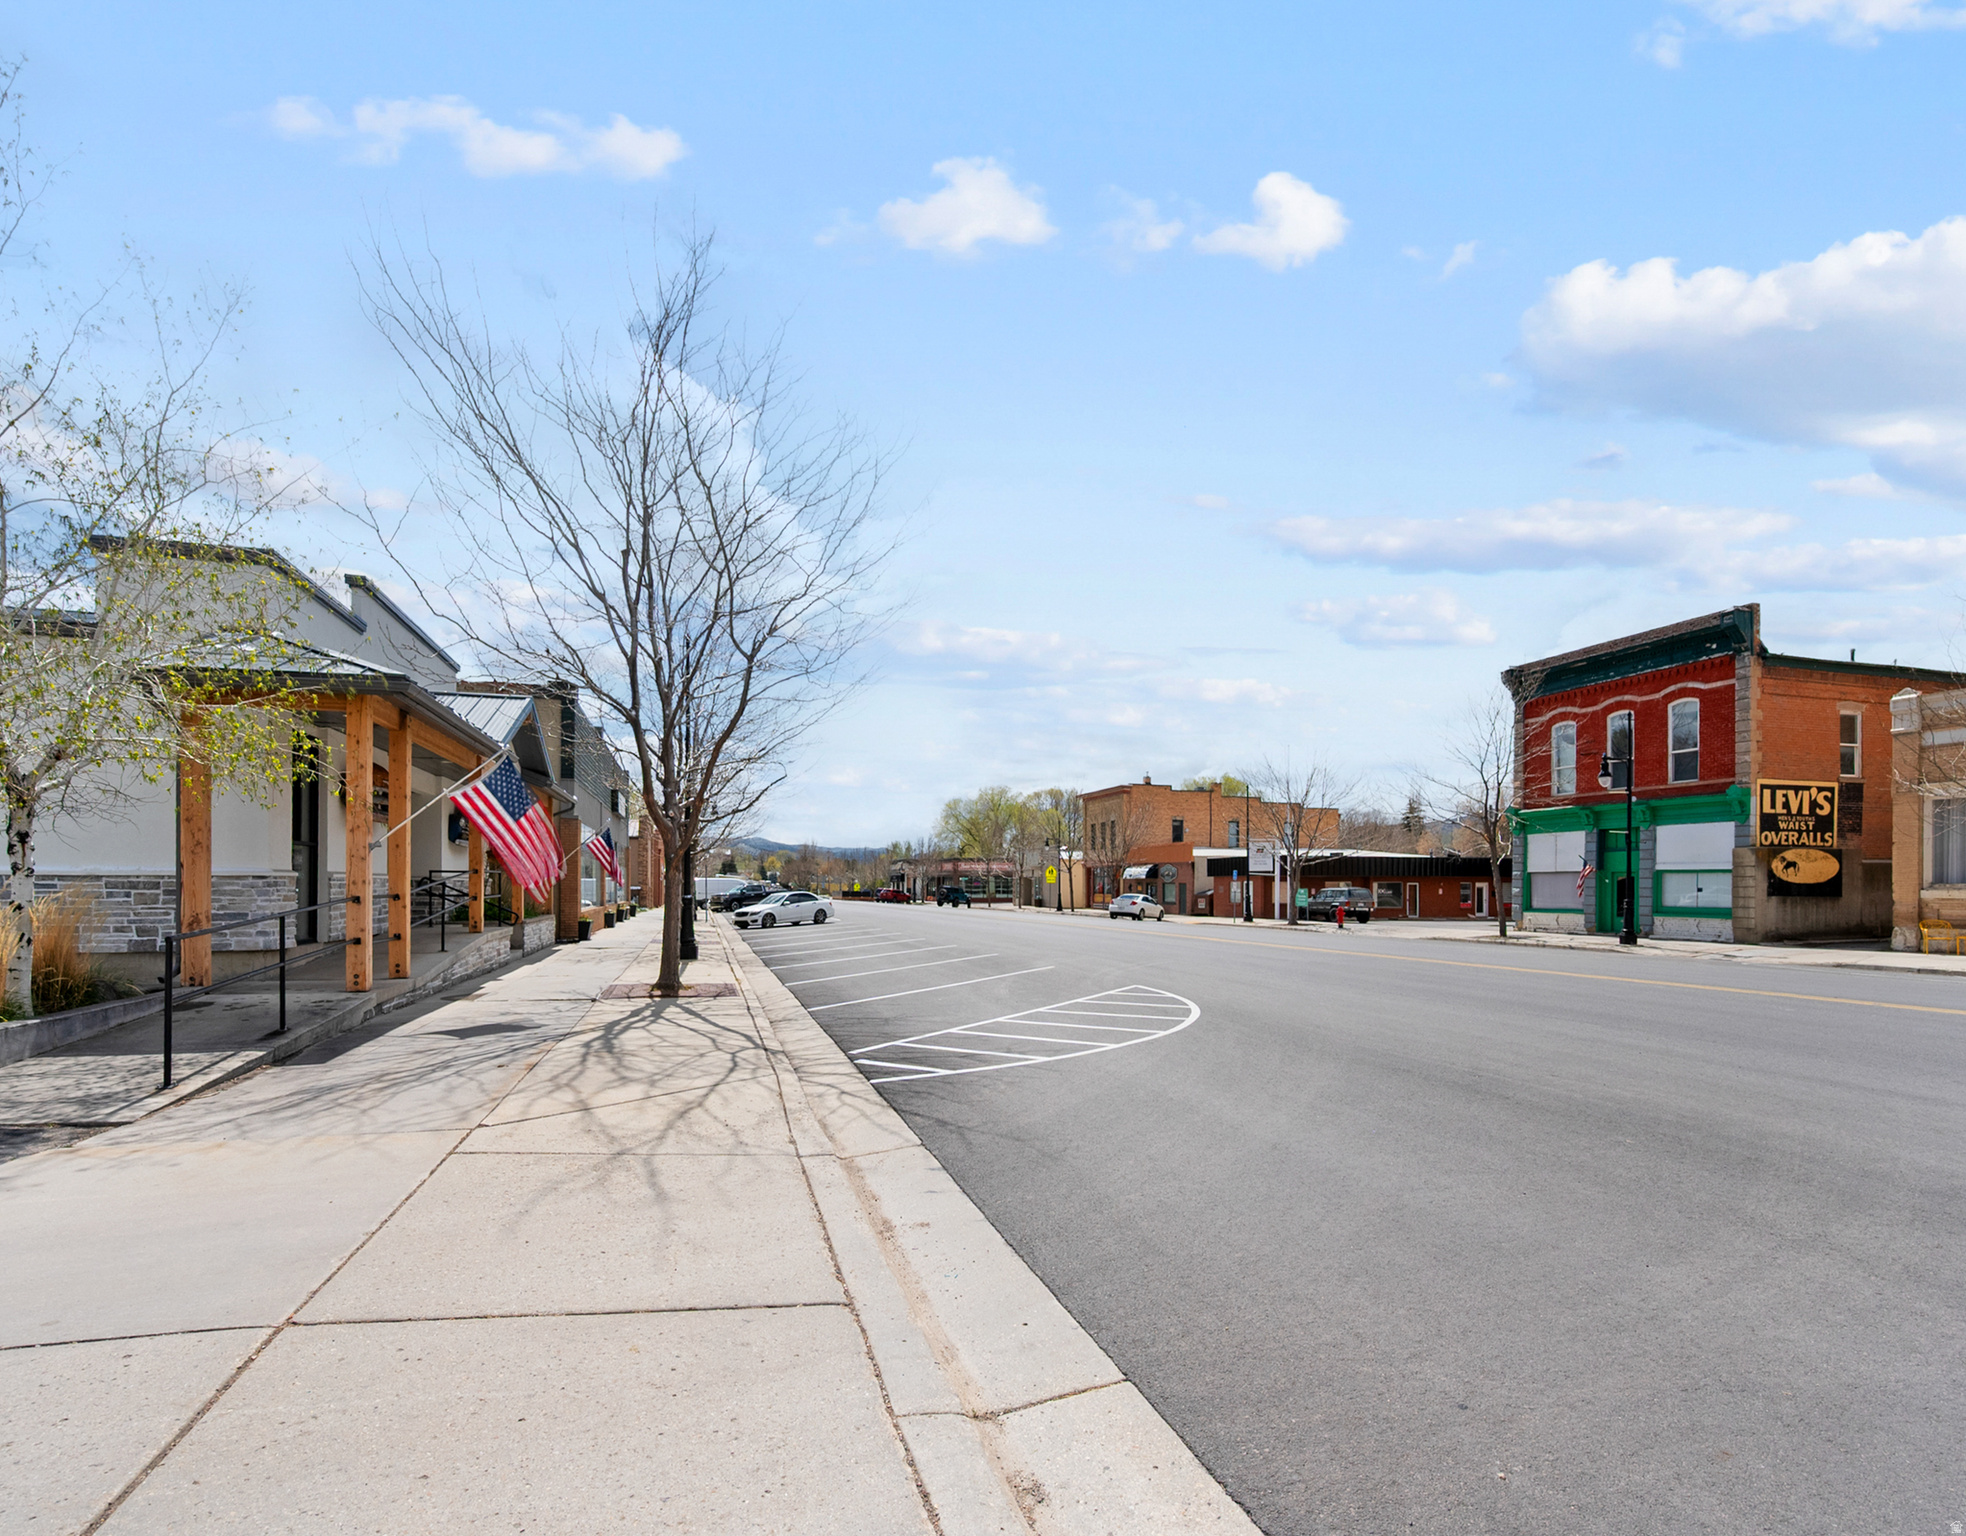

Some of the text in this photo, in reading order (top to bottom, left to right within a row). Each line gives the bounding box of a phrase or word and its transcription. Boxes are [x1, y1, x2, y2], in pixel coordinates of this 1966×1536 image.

[1762, 787, 1832, 816] LEVI'S
[1778, 821, 1815, 831] WAIST
[1761, 831, 1833, 847] OVERALLS
